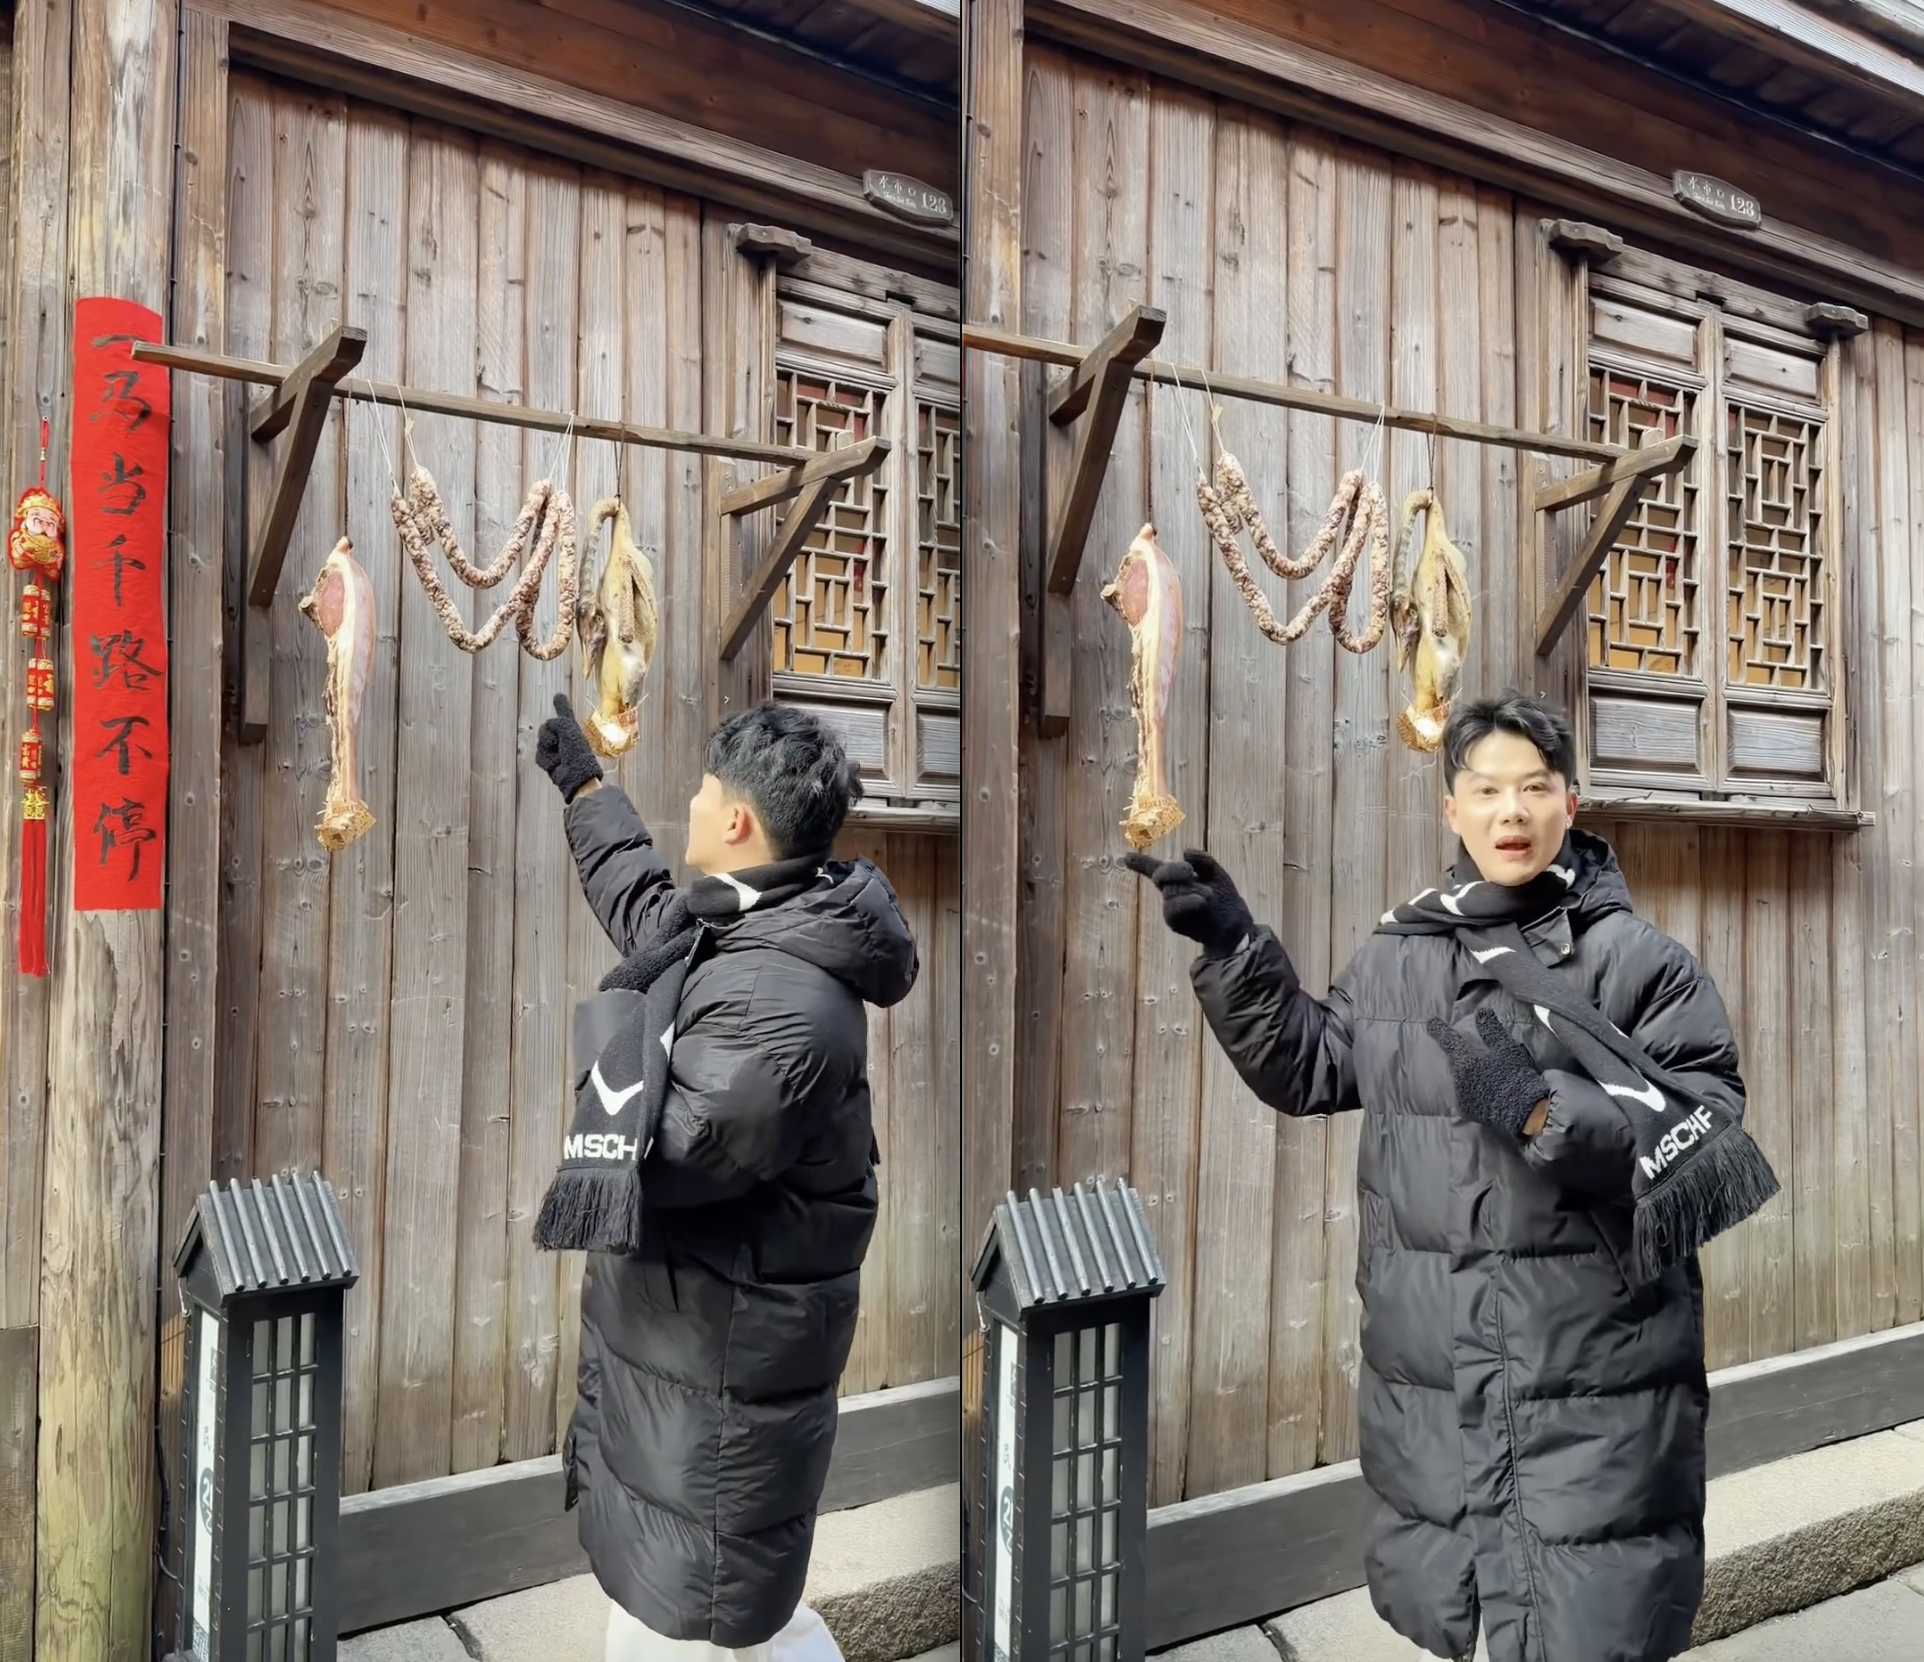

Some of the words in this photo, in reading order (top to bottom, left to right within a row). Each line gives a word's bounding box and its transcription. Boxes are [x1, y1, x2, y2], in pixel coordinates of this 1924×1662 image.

[921, 191, 948, 214] 128
[1730, 193, 1756, 218] 128
[563, 1133, 654, 1161] MSCH
[1638, 1104, 1713, 1180] MSCHF
